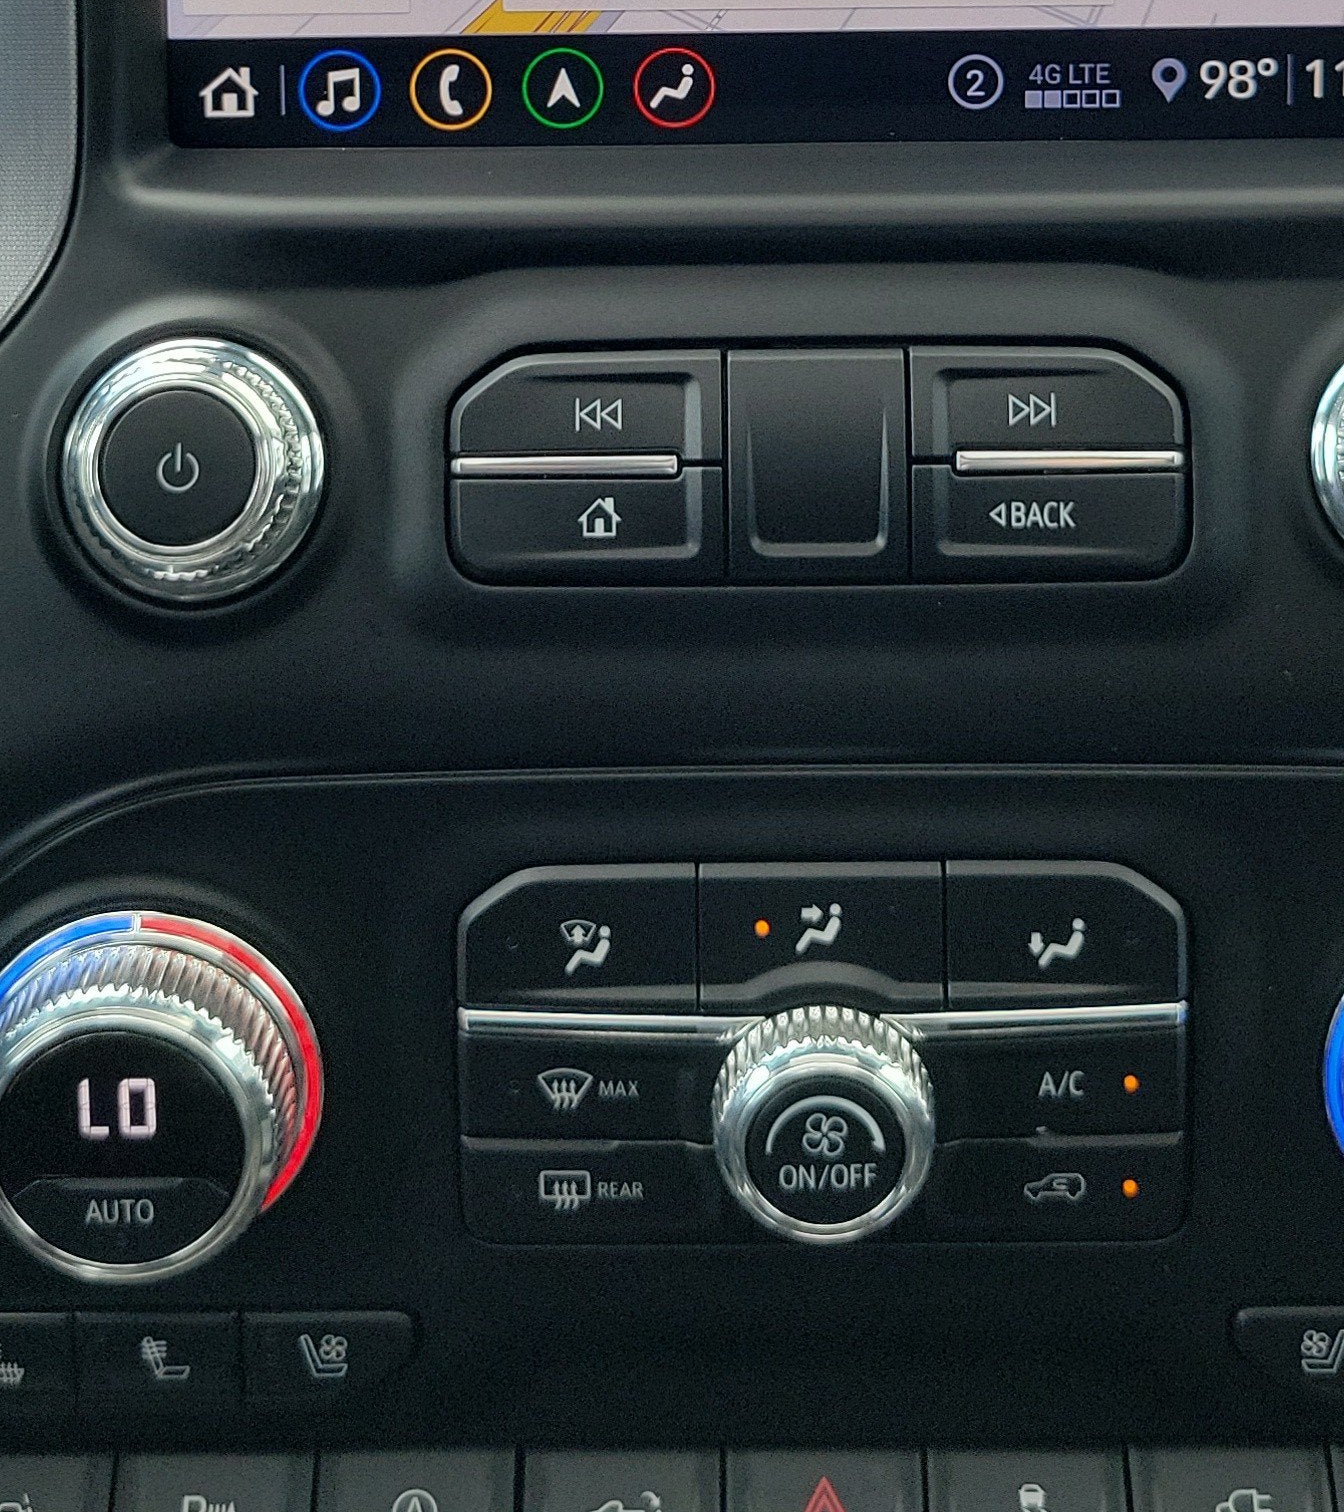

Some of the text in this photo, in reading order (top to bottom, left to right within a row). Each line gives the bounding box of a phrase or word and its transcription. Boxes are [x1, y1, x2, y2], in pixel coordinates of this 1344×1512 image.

[965, 69, 986, 97] 2
[1028, 62, 1111, 85] 4G LTE
[1199, 56, 1279, 100] 98°
[1011, 500, 1076, 530] BACK
[598, 1079, 639, 1097] MAX
[1038, 1070, 1085, 1098] A/C
[76, 1077, 158, 1141] LO
[597, 1180, 644, 1198] REAR
[777, 1162, 878, 1191] ON/OFF
[85, 1198, 155, 1228] AUTO
